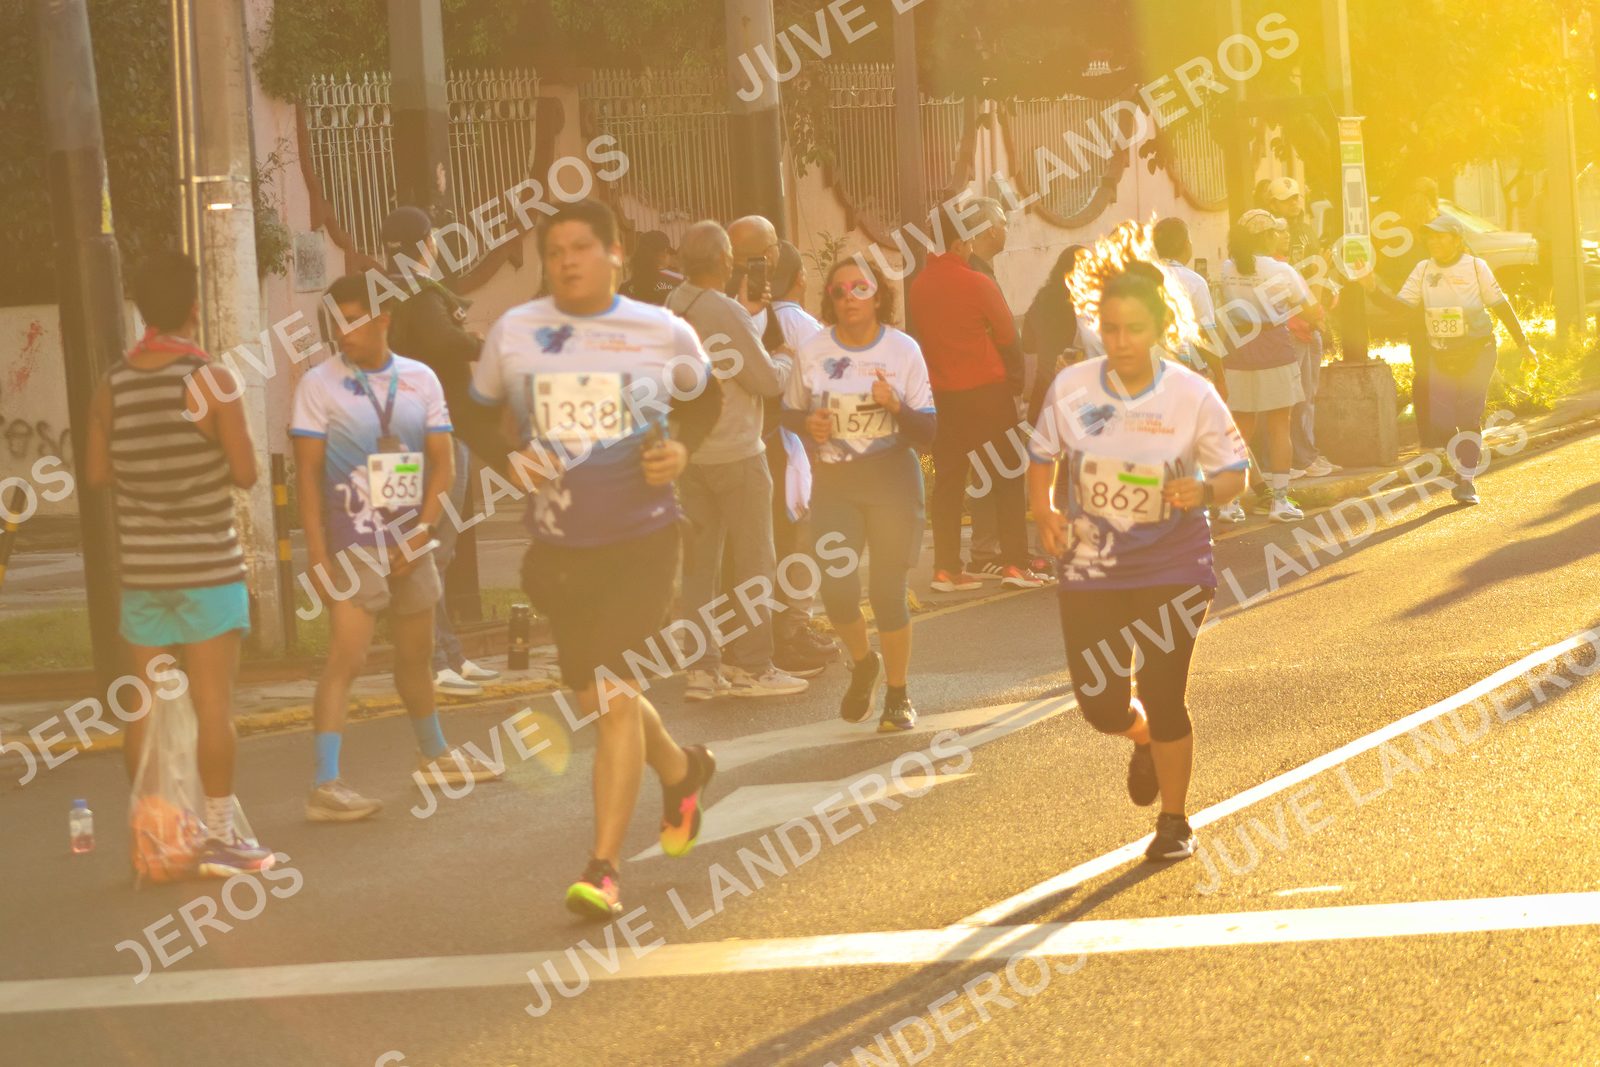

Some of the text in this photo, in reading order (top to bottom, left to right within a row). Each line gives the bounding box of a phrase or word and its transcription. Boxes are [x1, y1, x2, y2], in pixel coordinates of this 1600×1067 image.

[1432, 319, 1457, 333] 838
[541, 401, 618, 430] 1338
[832, 409, 889, 433] 1577
[382, 474, 418, 499] 655
[1091, 481, 1149, 514] 862
